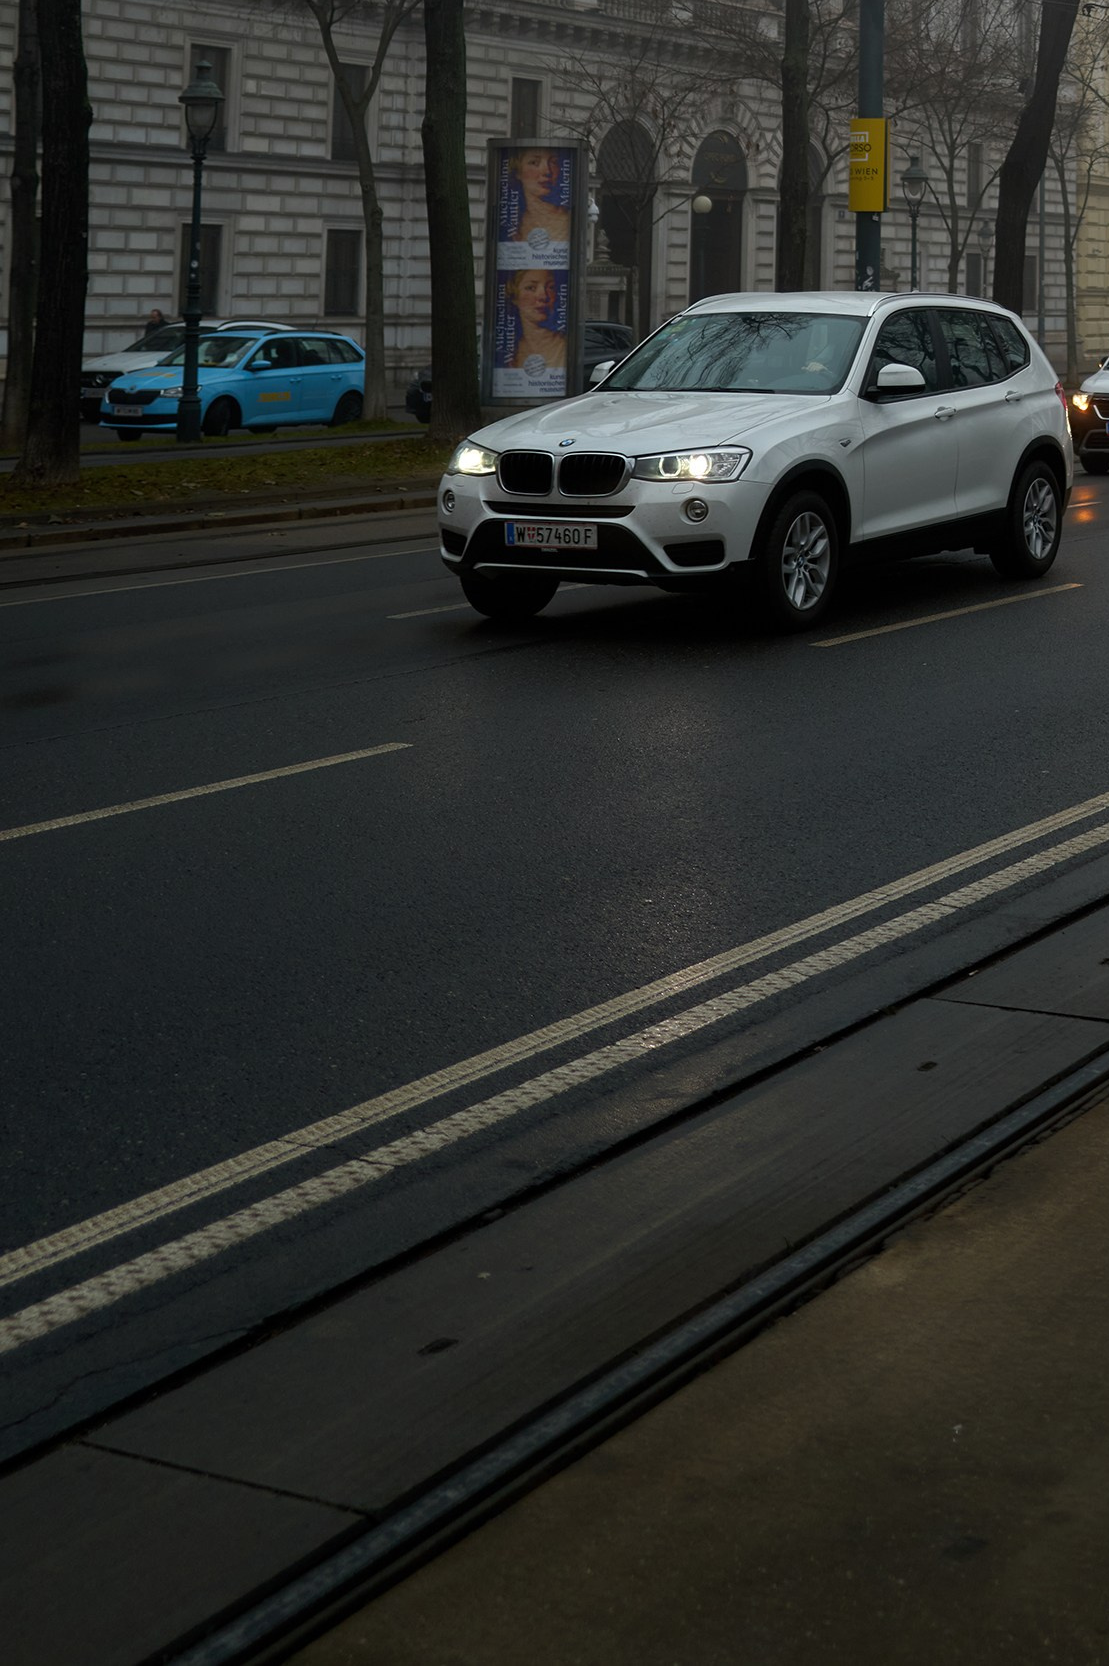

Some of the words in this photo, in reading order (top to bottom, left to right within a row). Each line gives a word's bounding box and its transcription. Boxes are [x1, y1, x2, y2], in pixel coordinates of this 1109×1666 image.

[500, 159, 509, 227] Michaelina
[560, 159, 571, 207] Malerin
[507, 189, 519, 238] Wautier
[496, 284, 506, 352] Michaelina
[557, 283, 568, 332] Malerin
[504, 314, 515, 364] Wautier
[516, 527, 526, 542] W
[537, 527, 580, 544] 57460
[584, 528, 592, 544] F
